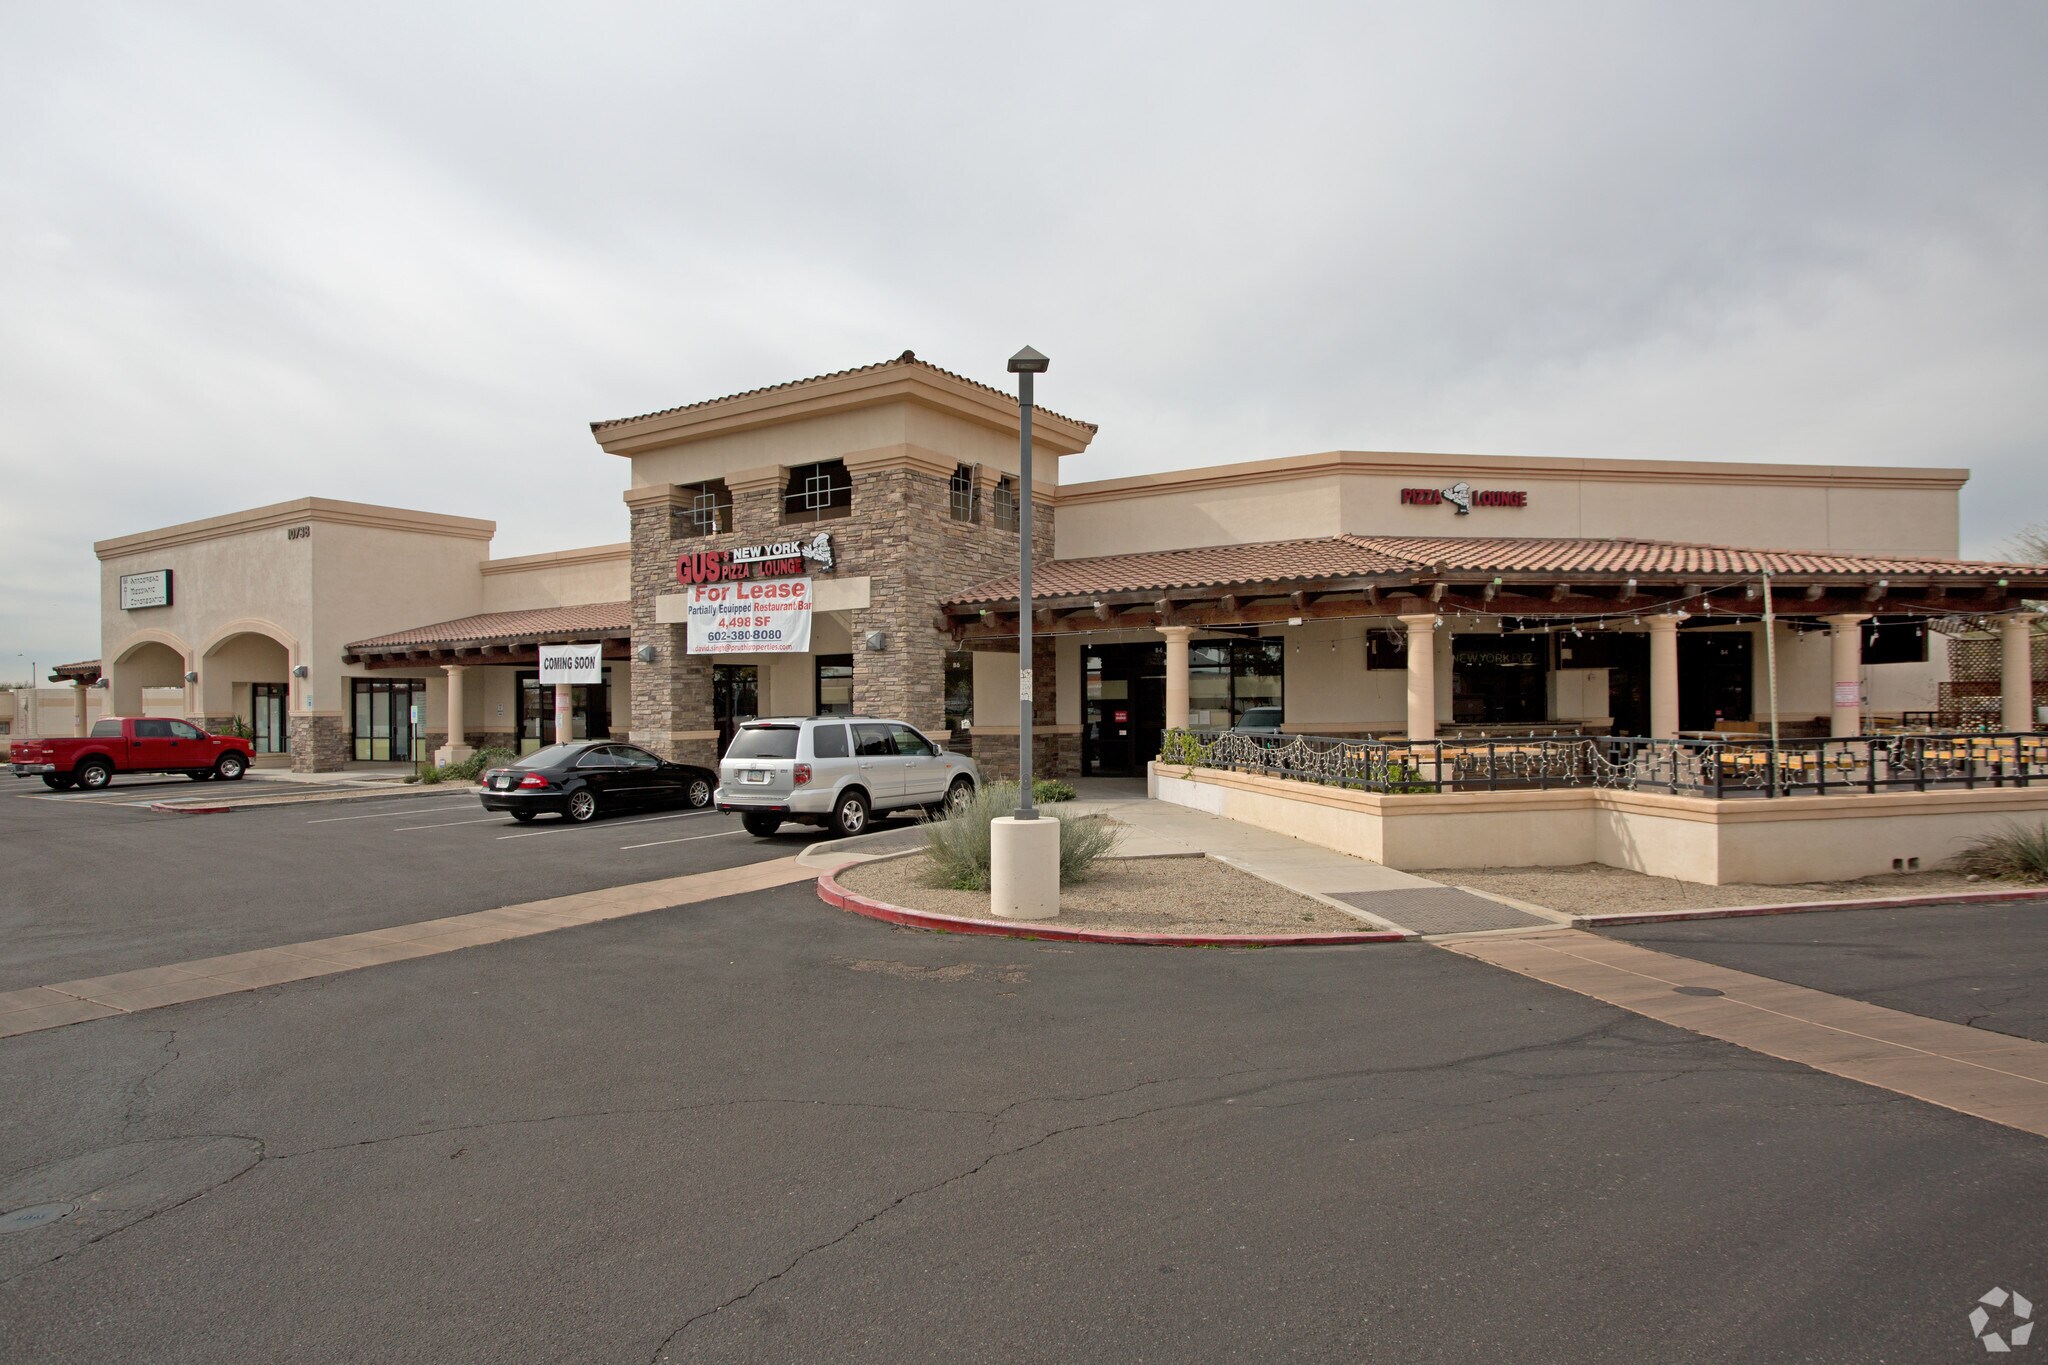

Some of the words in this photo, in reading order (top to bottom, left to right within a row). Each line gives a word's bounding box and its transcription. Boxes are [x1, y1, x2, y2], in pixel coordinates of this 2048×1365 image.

[1400, 488, 1443, 505] PIZZA
[1472, 490, 1528, 507] LOUNGE
[733, 548, 761, 559] NEW
[764, 542, 801, 555] YORK
[722, 564, 750, 580] PIZZA
[759, 558, 803, 576] LOUNGE
[695, 584, 730, 602] For
[737, 581, 805, 600] Lease
[688, 604, 717, 617] Partially
[718, 603, 752, 615] Equipped
[718, 616, 751, 630] 4,498
[754, 616, 771, 627] SF
[707, 629, 782, 641] 602-380-8080
[544, 657, 573, 670] COMING
[574, 656, 596, 669] SOON
[1480, 653, 1510, 663] YORK
